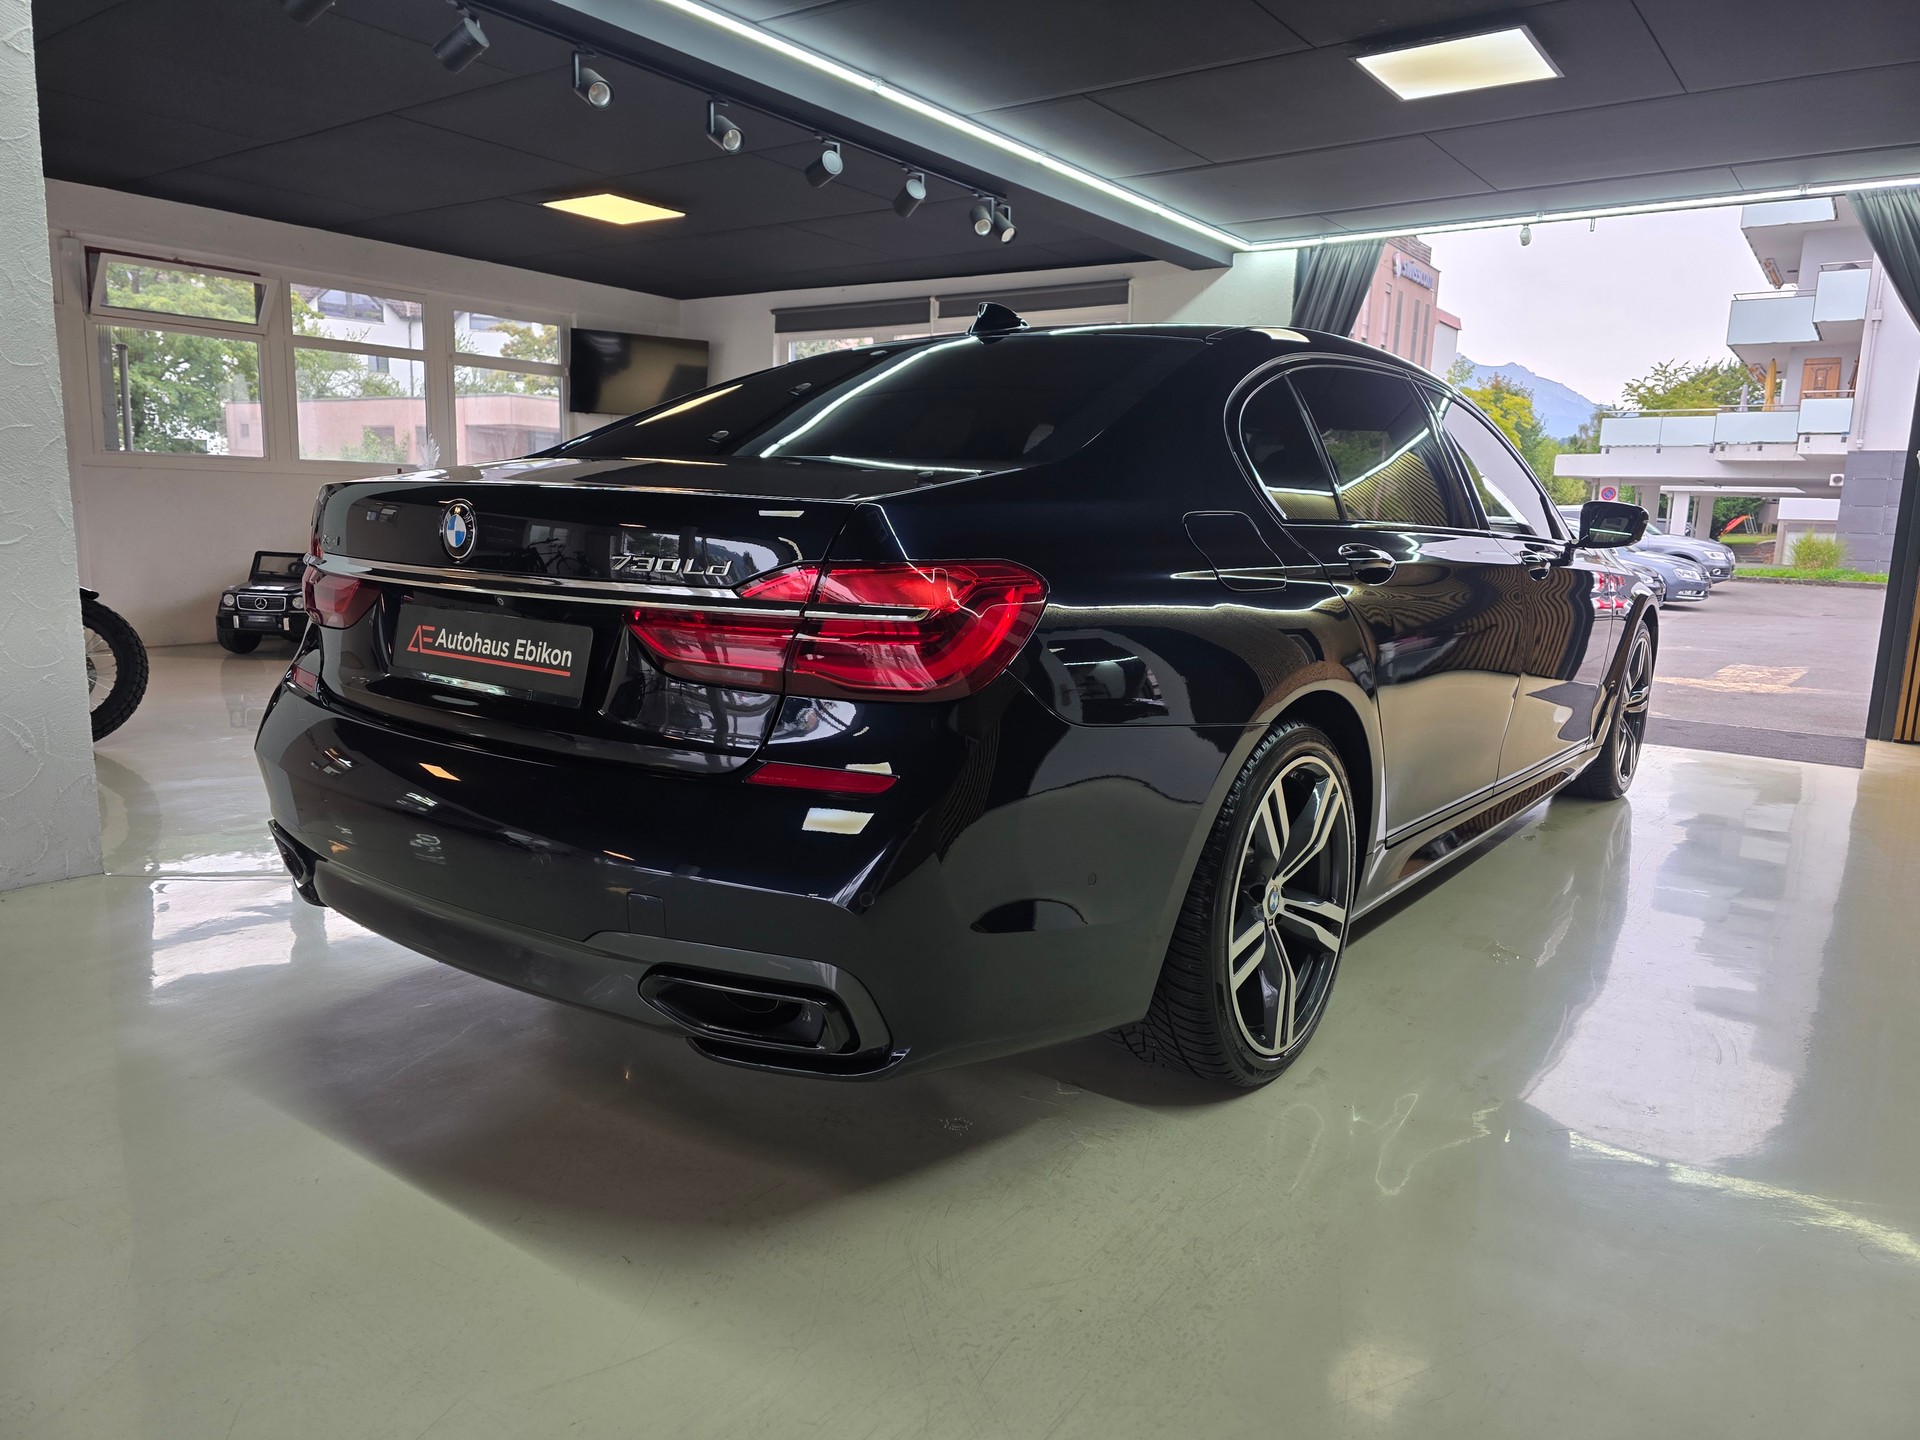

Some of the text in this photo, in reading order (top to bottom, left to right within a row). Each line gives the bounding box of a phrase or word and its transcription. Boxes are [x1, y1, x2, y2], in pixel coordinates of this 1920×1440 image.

[611, 555, 732, 576] 730Ld
[435, 628, 510, 658] Autohaus
[513, 638, 572, 668] Ebikon
